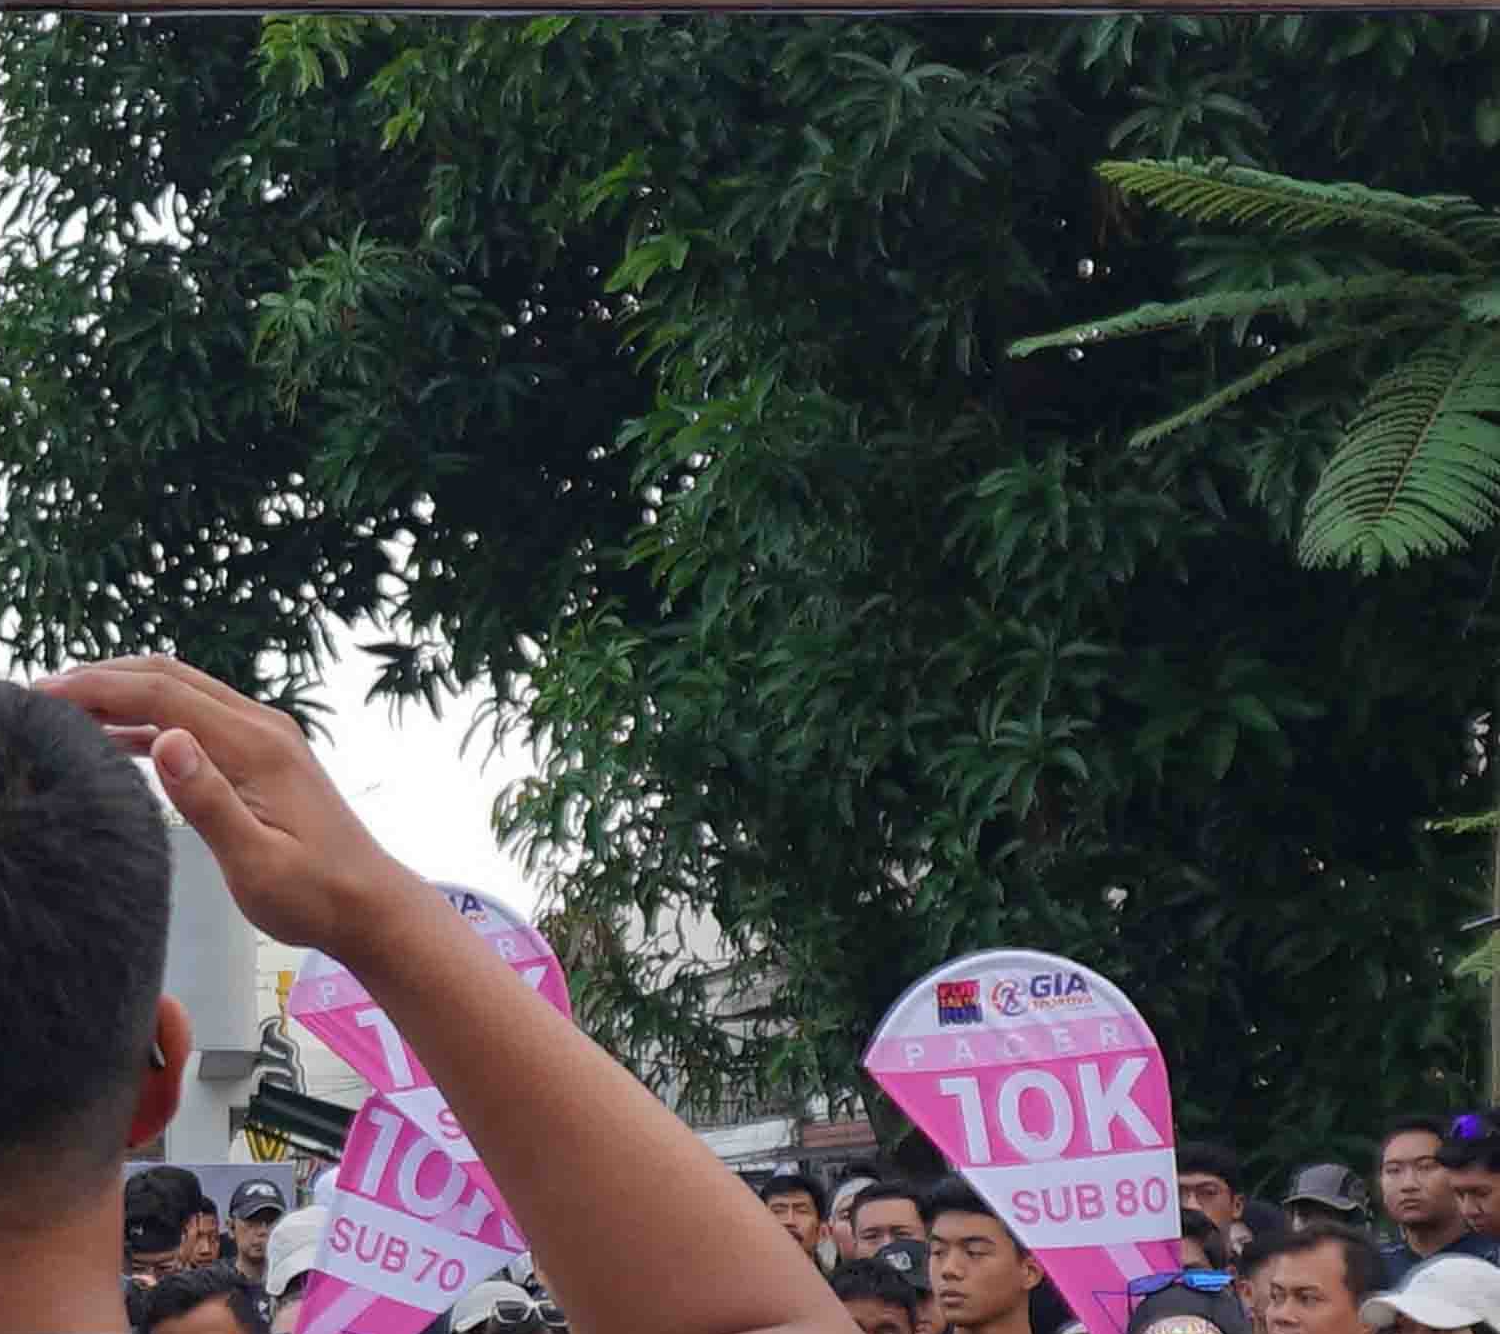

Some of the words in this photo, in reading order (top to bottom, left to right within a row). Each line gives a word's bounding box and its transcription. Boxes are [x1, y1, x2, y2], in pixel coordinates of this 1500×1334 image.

[1030, 972, 1089, 998] GIA
[904, 1022, 1124, 1067] PACER
[939, 1056, 1165, 1165] 10K
[1011, 1183, 1106, 1226] SUB
[1115, 1175, 1169, 1218] 80
[329, 1217, 410, 1274] SUB
[413, 1249, 467, 1293] 70
